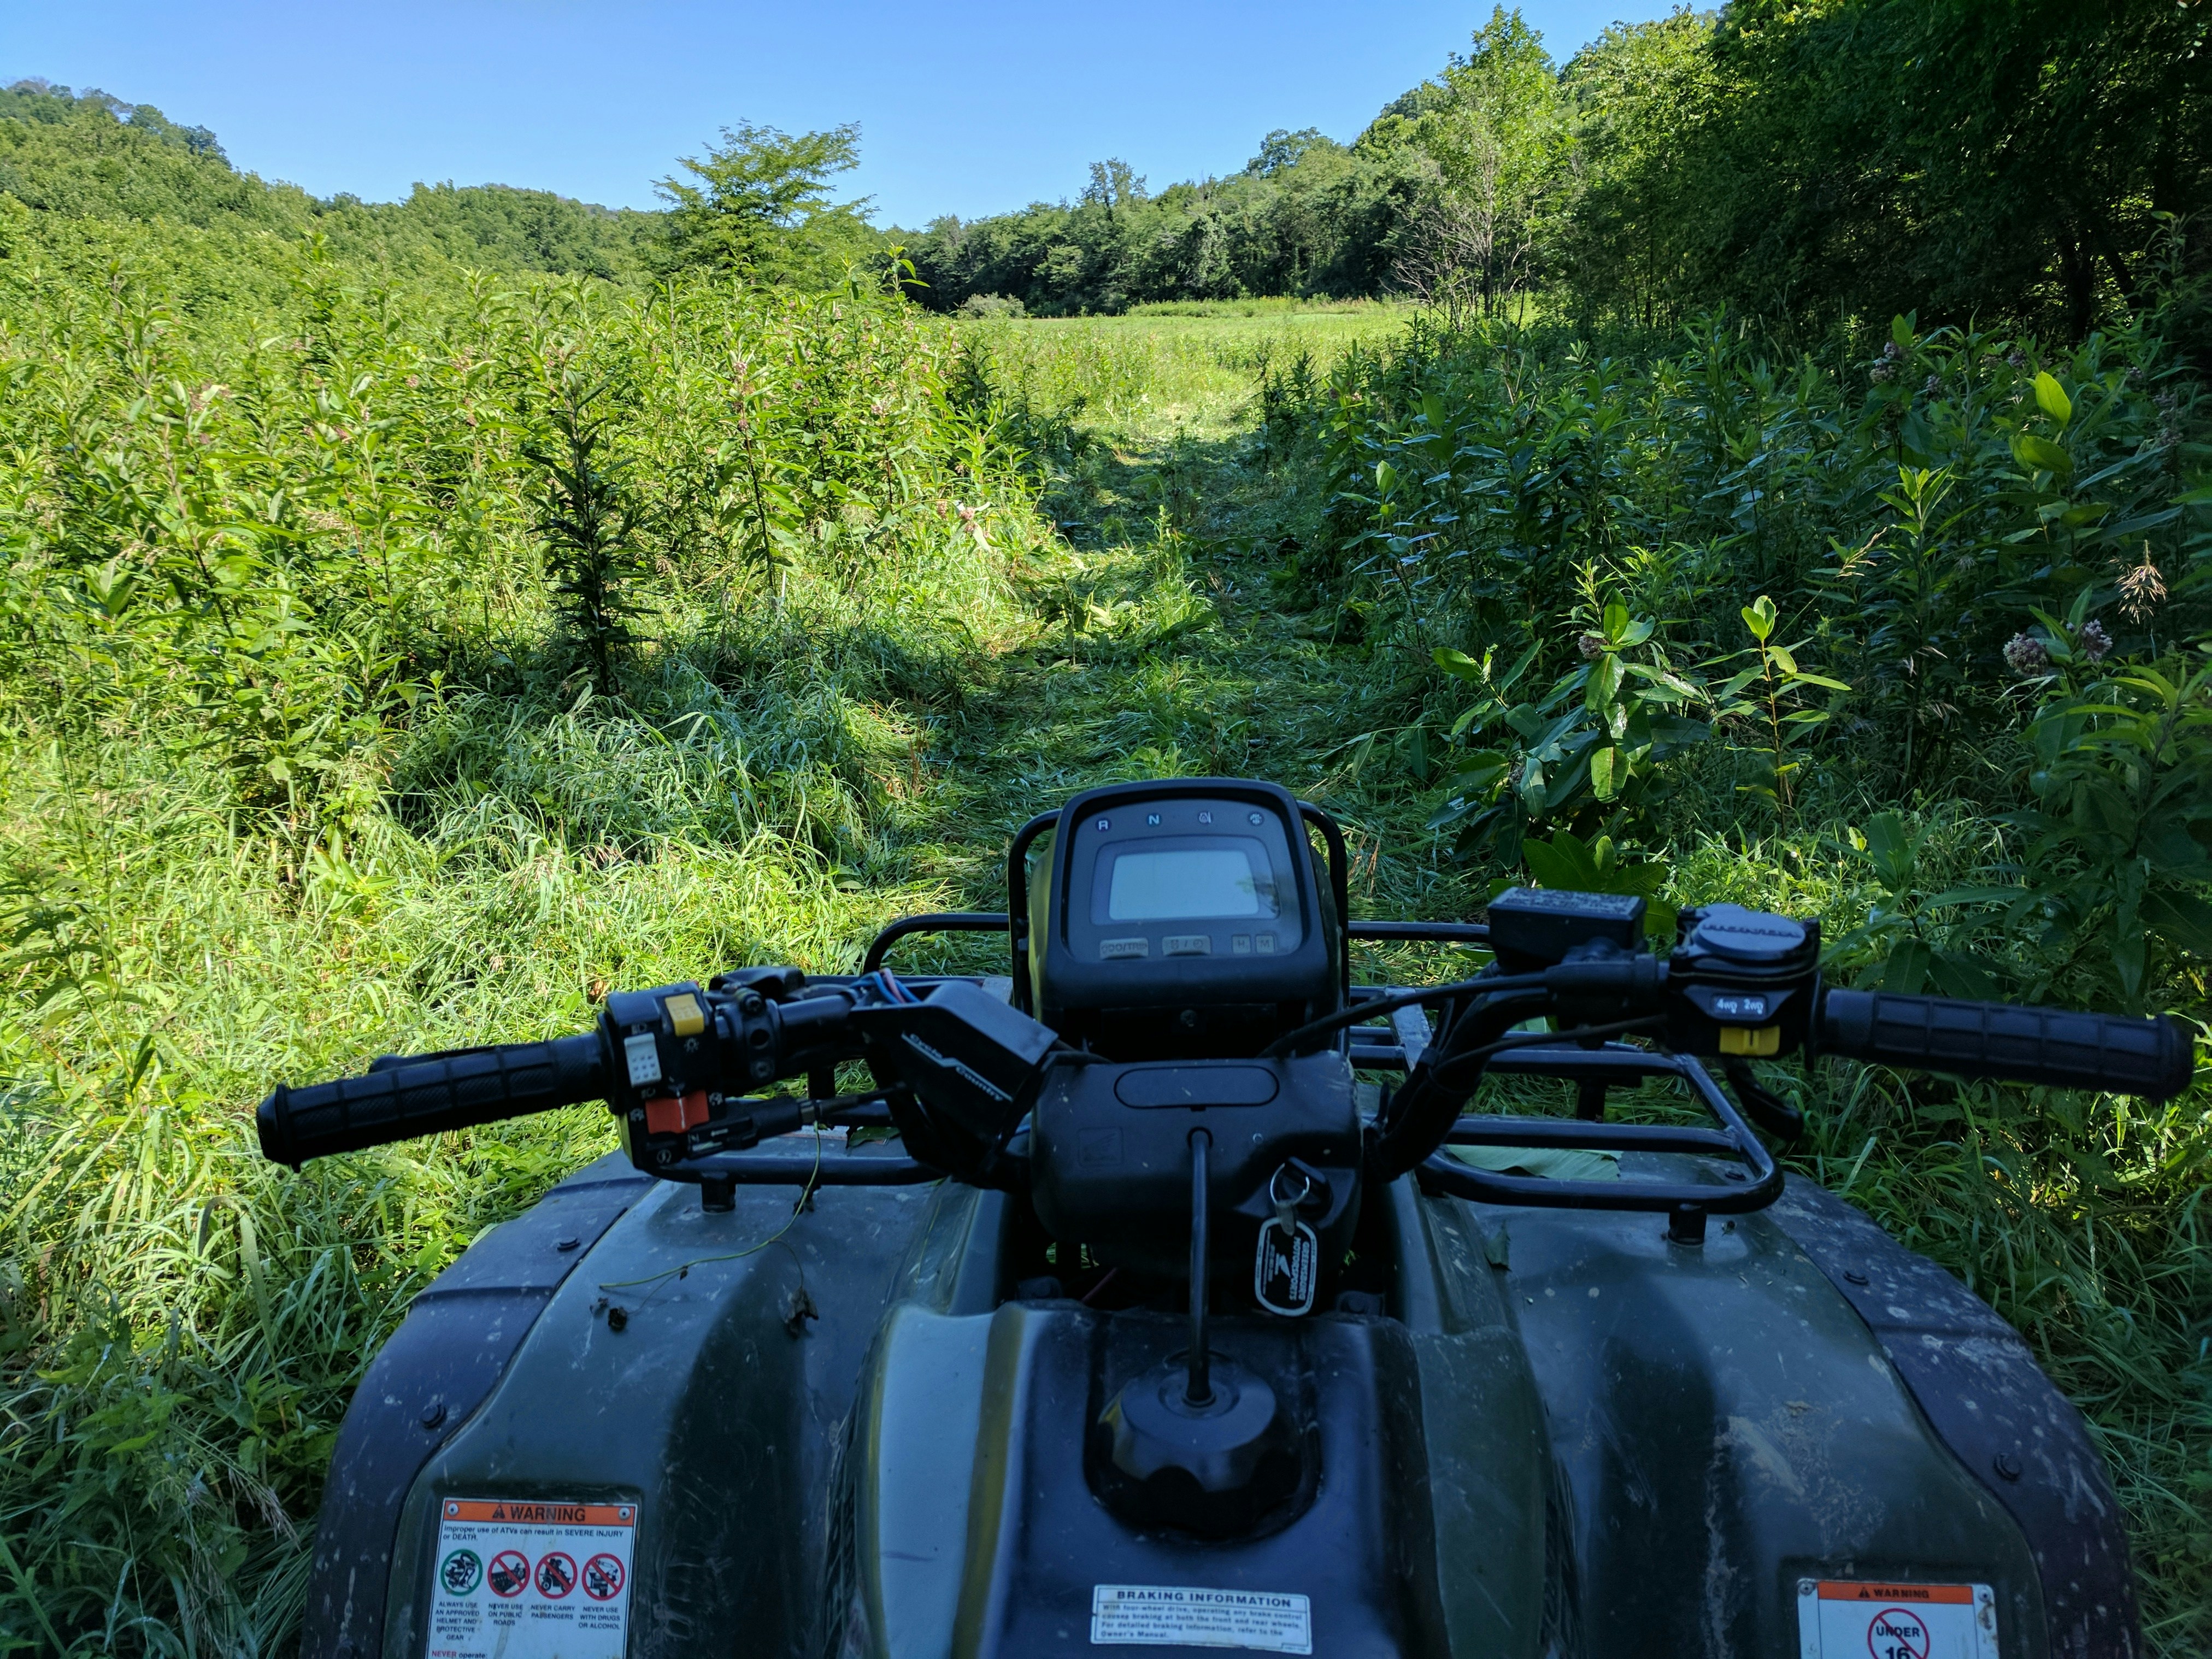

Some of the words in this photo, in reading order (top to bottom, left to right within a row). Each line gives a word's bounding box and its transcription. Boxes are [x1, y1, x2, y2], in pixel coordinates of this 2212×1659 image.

[1149, 814, 1160, 825] N
[1098, 820, 1109, 831] R
[510, 1506, 586, 1522] WARNING
[444, 1525, 475, 1533] Improper
[452, 1533, 478, 1541] DEATH.
[1117, 1591, 1184, 1601] BRAKING
[1190, 1593, 1291, 1607] INFORMATION
[1873, 1588, 1929, 1599] WARNING
[1876, 1626, 1920, 1638] UNDER
[1885, 1646, 1911, 1659] 16
